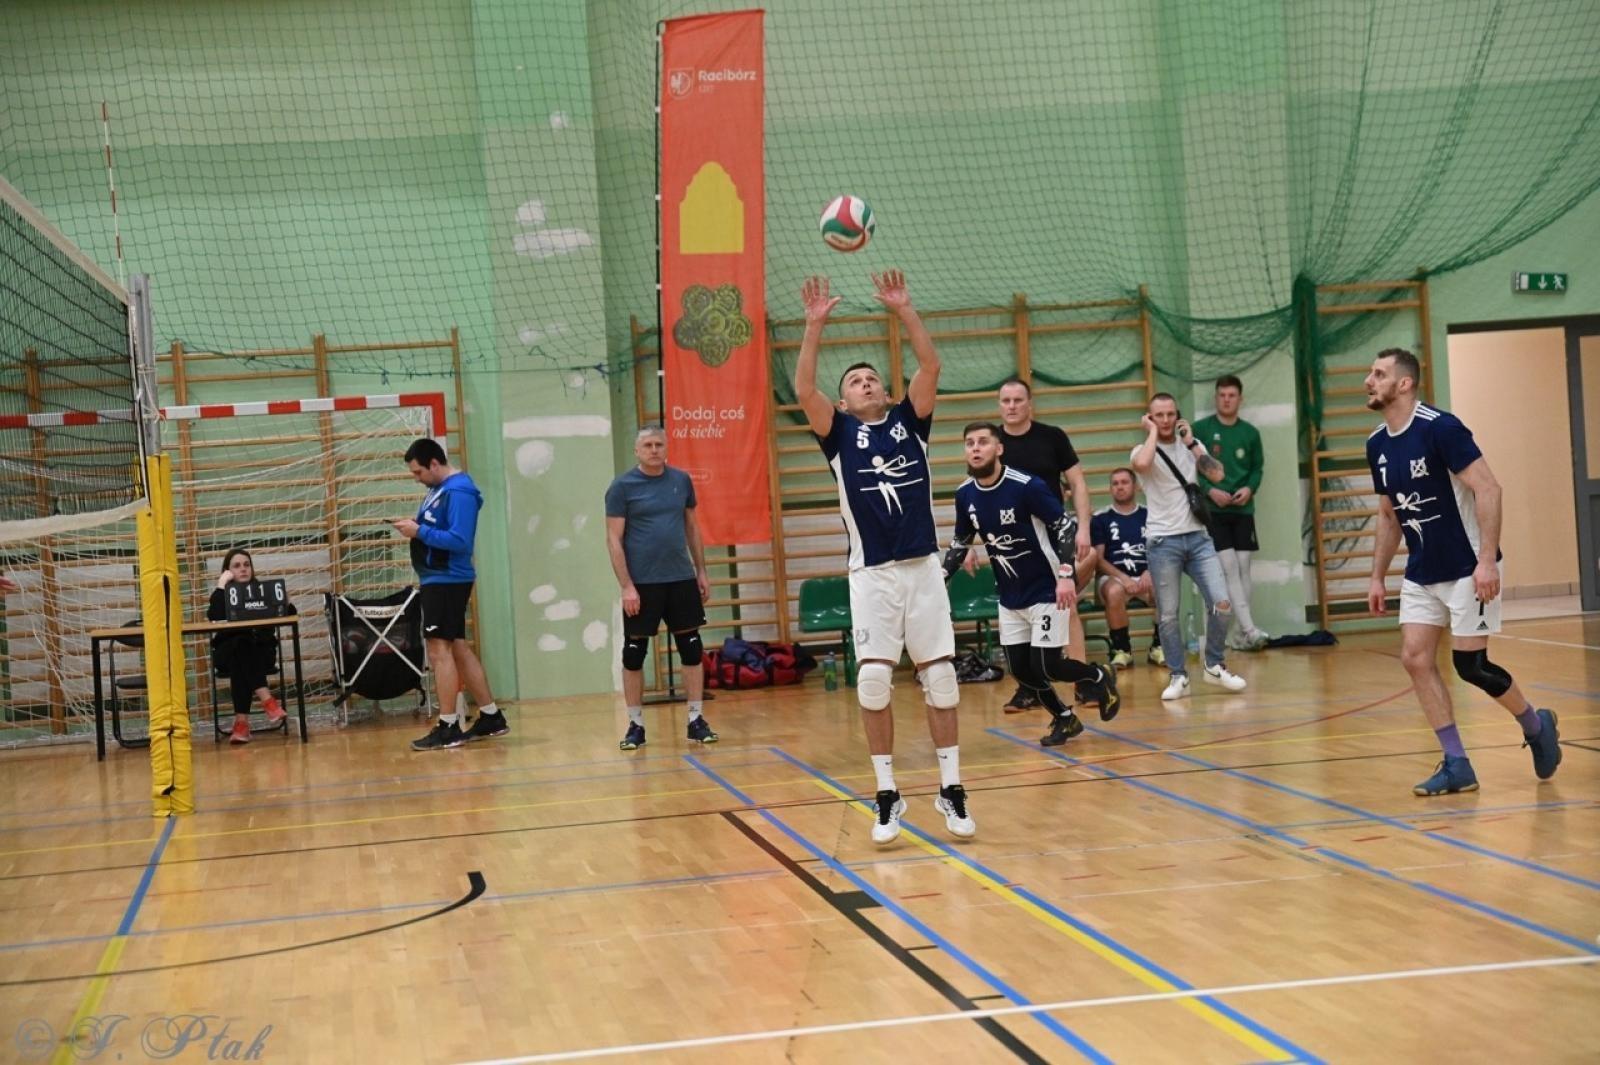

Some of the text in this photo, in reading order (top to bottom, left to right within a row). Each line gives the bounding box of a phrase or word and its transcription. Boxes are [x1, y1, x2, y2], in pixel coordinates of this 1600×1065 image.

[698, 68, 757, 82] Racibórz
[672, 405, 745, 424] Dodaj coś
[672, 424, 726, 439] od siebie
[856, 430, 870, 450] 5
[1110, 527, 1120, 541] 2
[229, 587, 239, 606] 8
[274, 582, 284, 601] 6
[1041, 614, 1052, 632] 3
